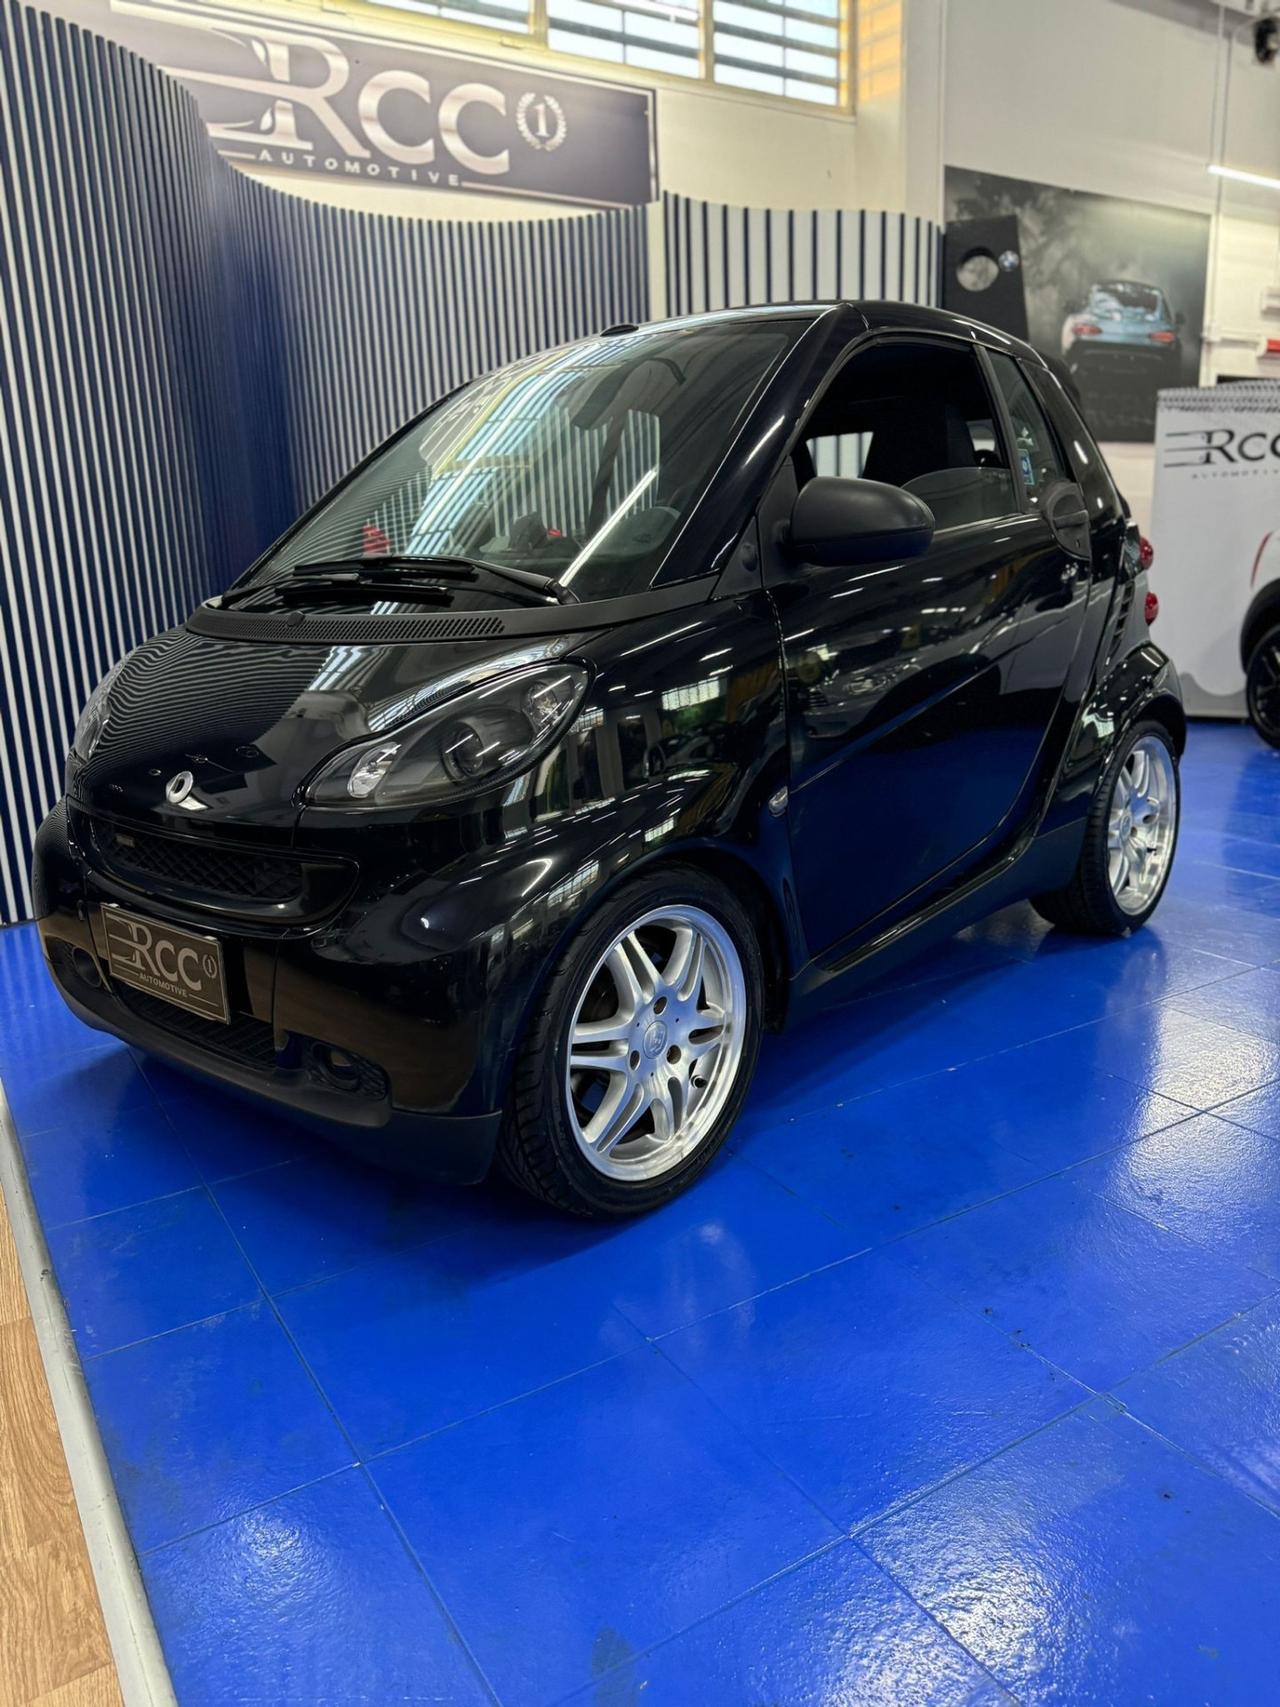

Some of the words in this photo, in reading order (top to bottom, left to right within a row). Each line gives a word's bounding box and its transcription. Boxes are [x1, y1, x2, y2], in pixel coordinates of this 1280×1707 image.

[264, 34, 509, 175] RCC
[259, 149, 462, 187] AUTOMOTIVE
[130, 922, 202, 991] RCC
[138, 972, 188, 997] AUTOMOTIVE
